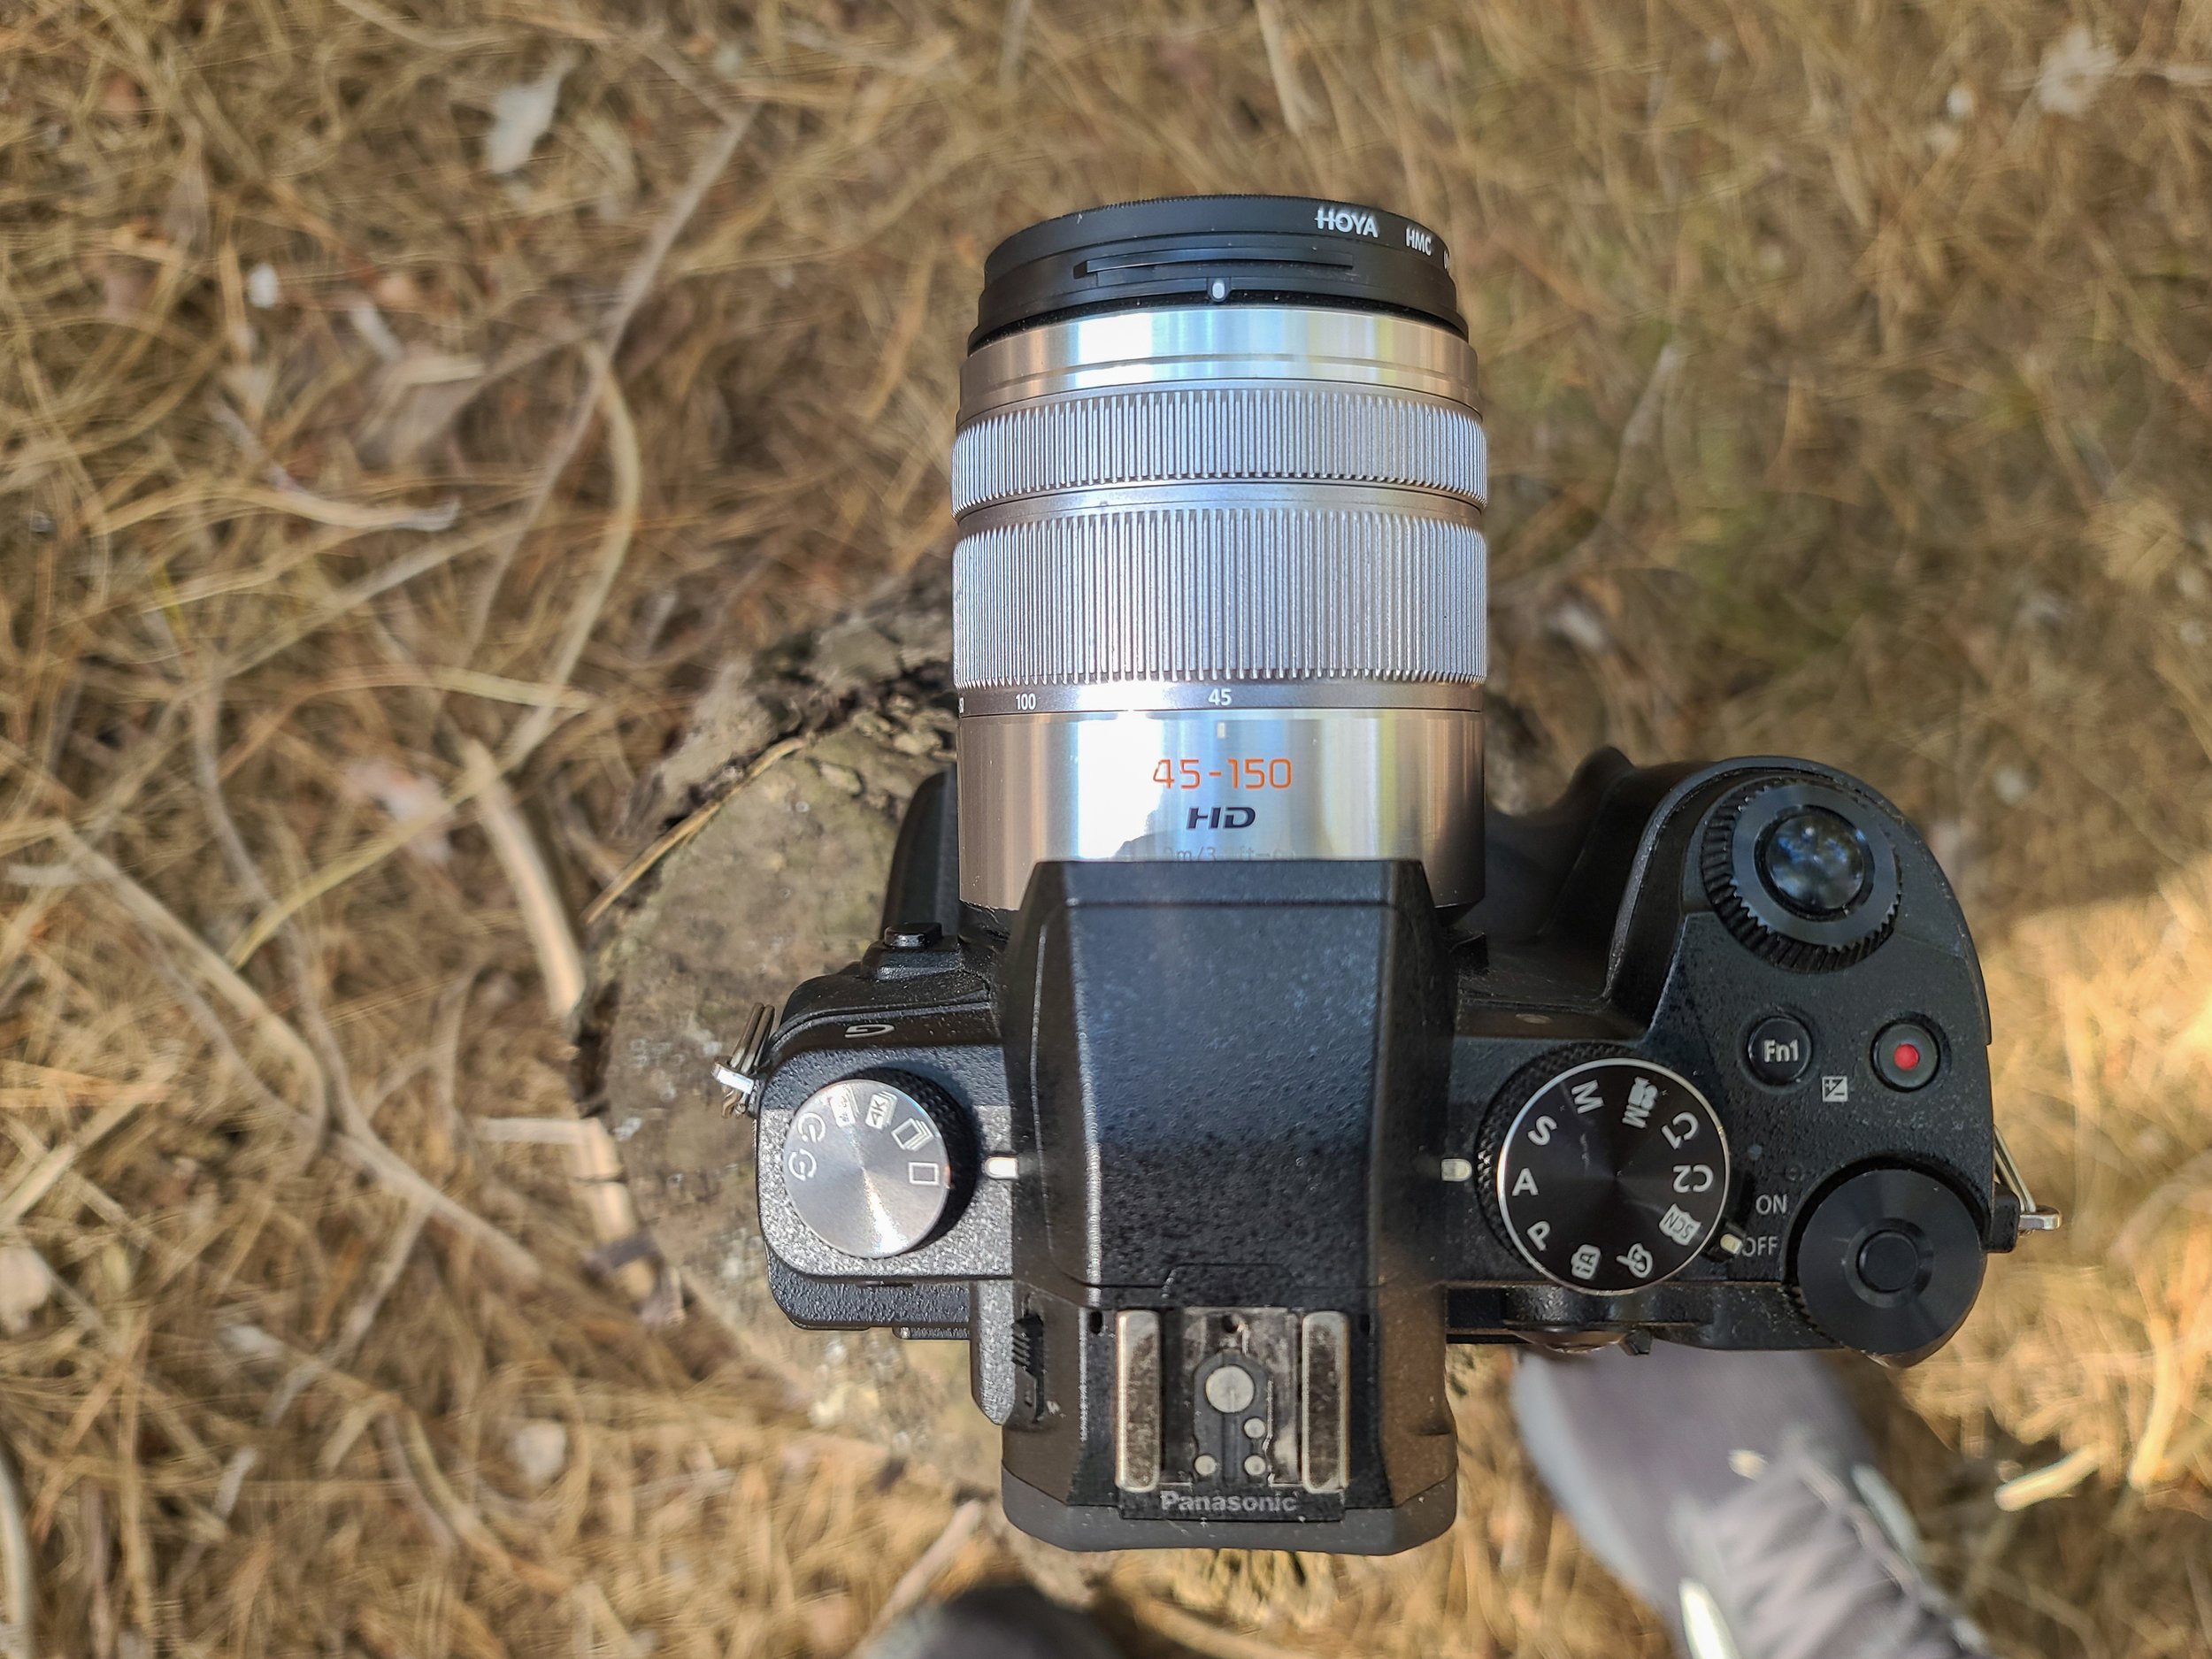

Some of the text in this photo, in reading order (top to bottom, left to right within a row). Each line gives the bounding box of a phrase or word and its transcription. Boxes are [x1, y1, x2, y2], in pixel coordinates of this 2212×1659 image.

[1315, 209, 1432, 256] HOYA HMC
[1016, 688, 1232, 710] 100 45
[1153, 758, 1293, 789] 45-150
[1187, 806, 1256, 829] HD
[1763, 1039, 1799, 1063] Fn1
[1571, 1079, 1604, 1114] M
[870, 1098, 886, 1126] 4K
[1527, 1115, 1557, 1146] S
[1661, 1111, 1699, 1150] C1
[1511, 1168, 1539, 1196] A
[1672, 1164, 1714, 1194] C2
[1755, 1194, 1787, 1215] ON
[1526, 1220, 1551, 1251] P
[1741, 1235, 1778, 1257] OFF
[1160, 1490, 1297, 1511] Panasonic
